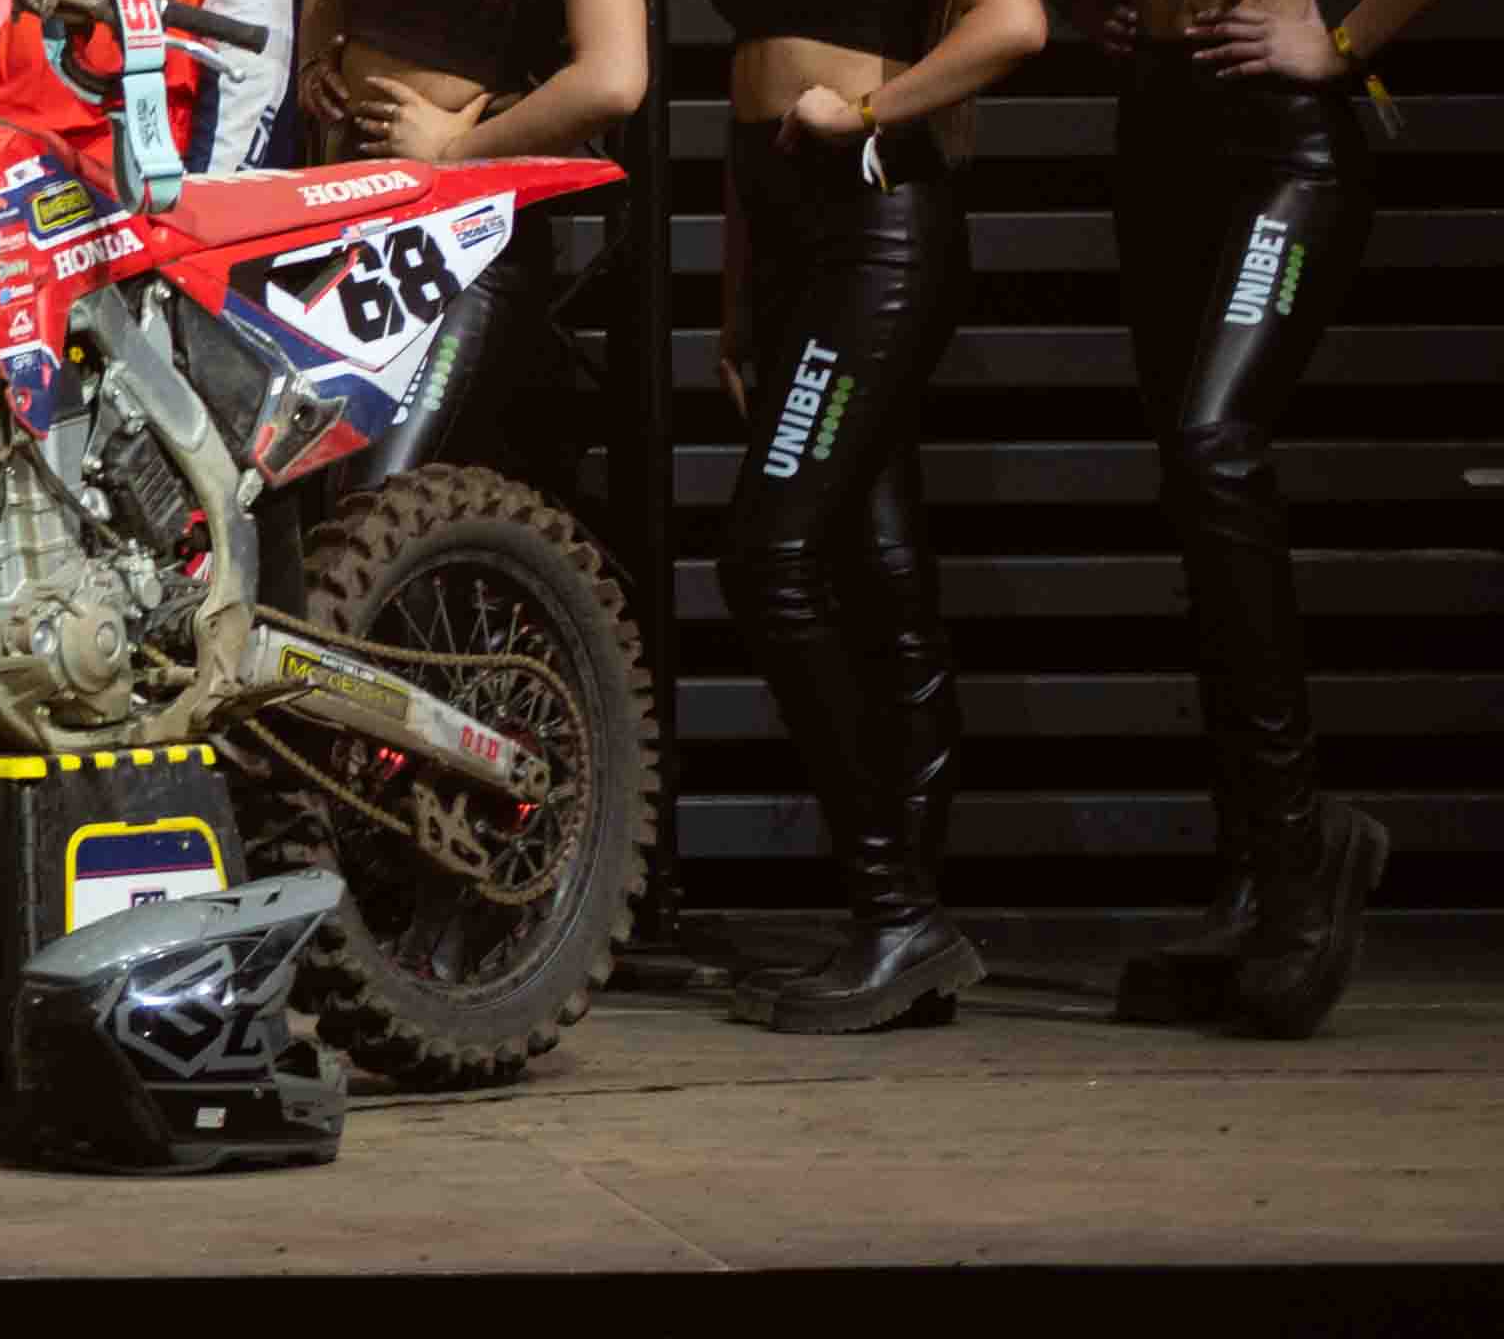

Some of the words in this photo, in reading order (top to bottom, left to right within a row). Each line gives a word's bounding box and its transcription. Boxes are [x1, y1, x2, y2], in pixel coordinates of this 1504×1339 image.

[303, 169, 420, 208] HONDA
[52, 227, 145, 280] HONDA
[338, 224, 464, 347] 68
[1224, 212, 1289, 325] UNIBET
[763, 339, 838, 479] UNIBET
